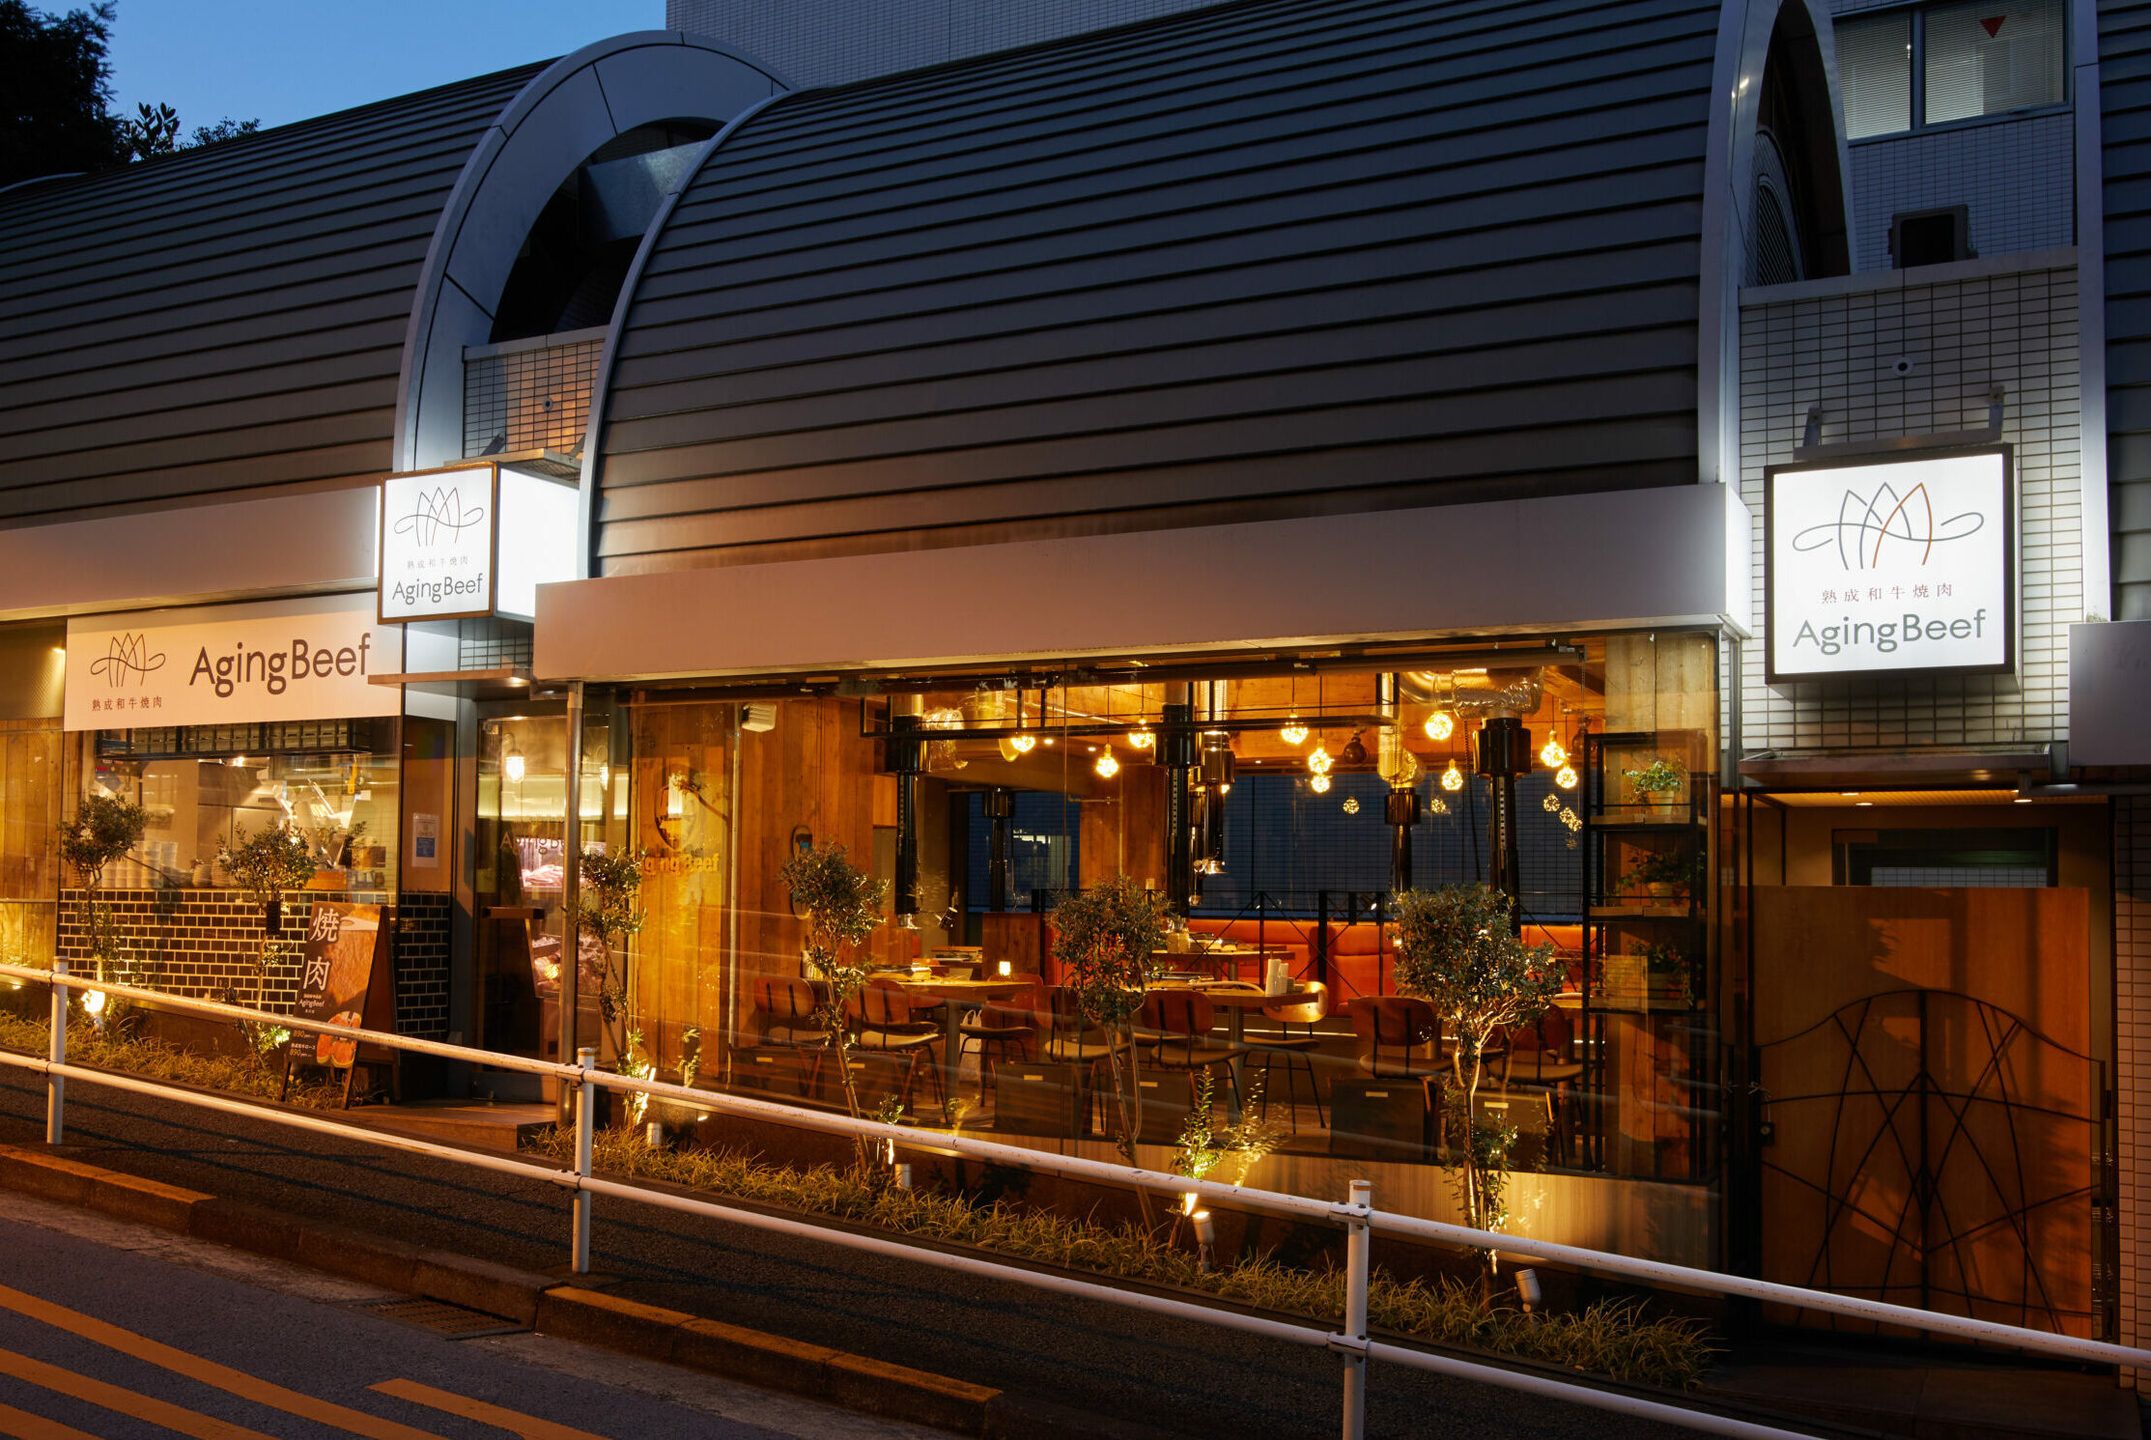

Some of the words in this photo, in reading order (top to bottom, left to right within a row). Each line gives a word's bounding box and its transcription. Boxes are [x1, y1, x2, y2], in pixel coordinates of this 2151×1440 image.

[392, 573, 483, 605] AgingBeef
[1793, 608, 1986, 656] AgingBeef
[189, 632, 371, 698] AgingBeef
[303, 907, 339, 991] 焼肉
